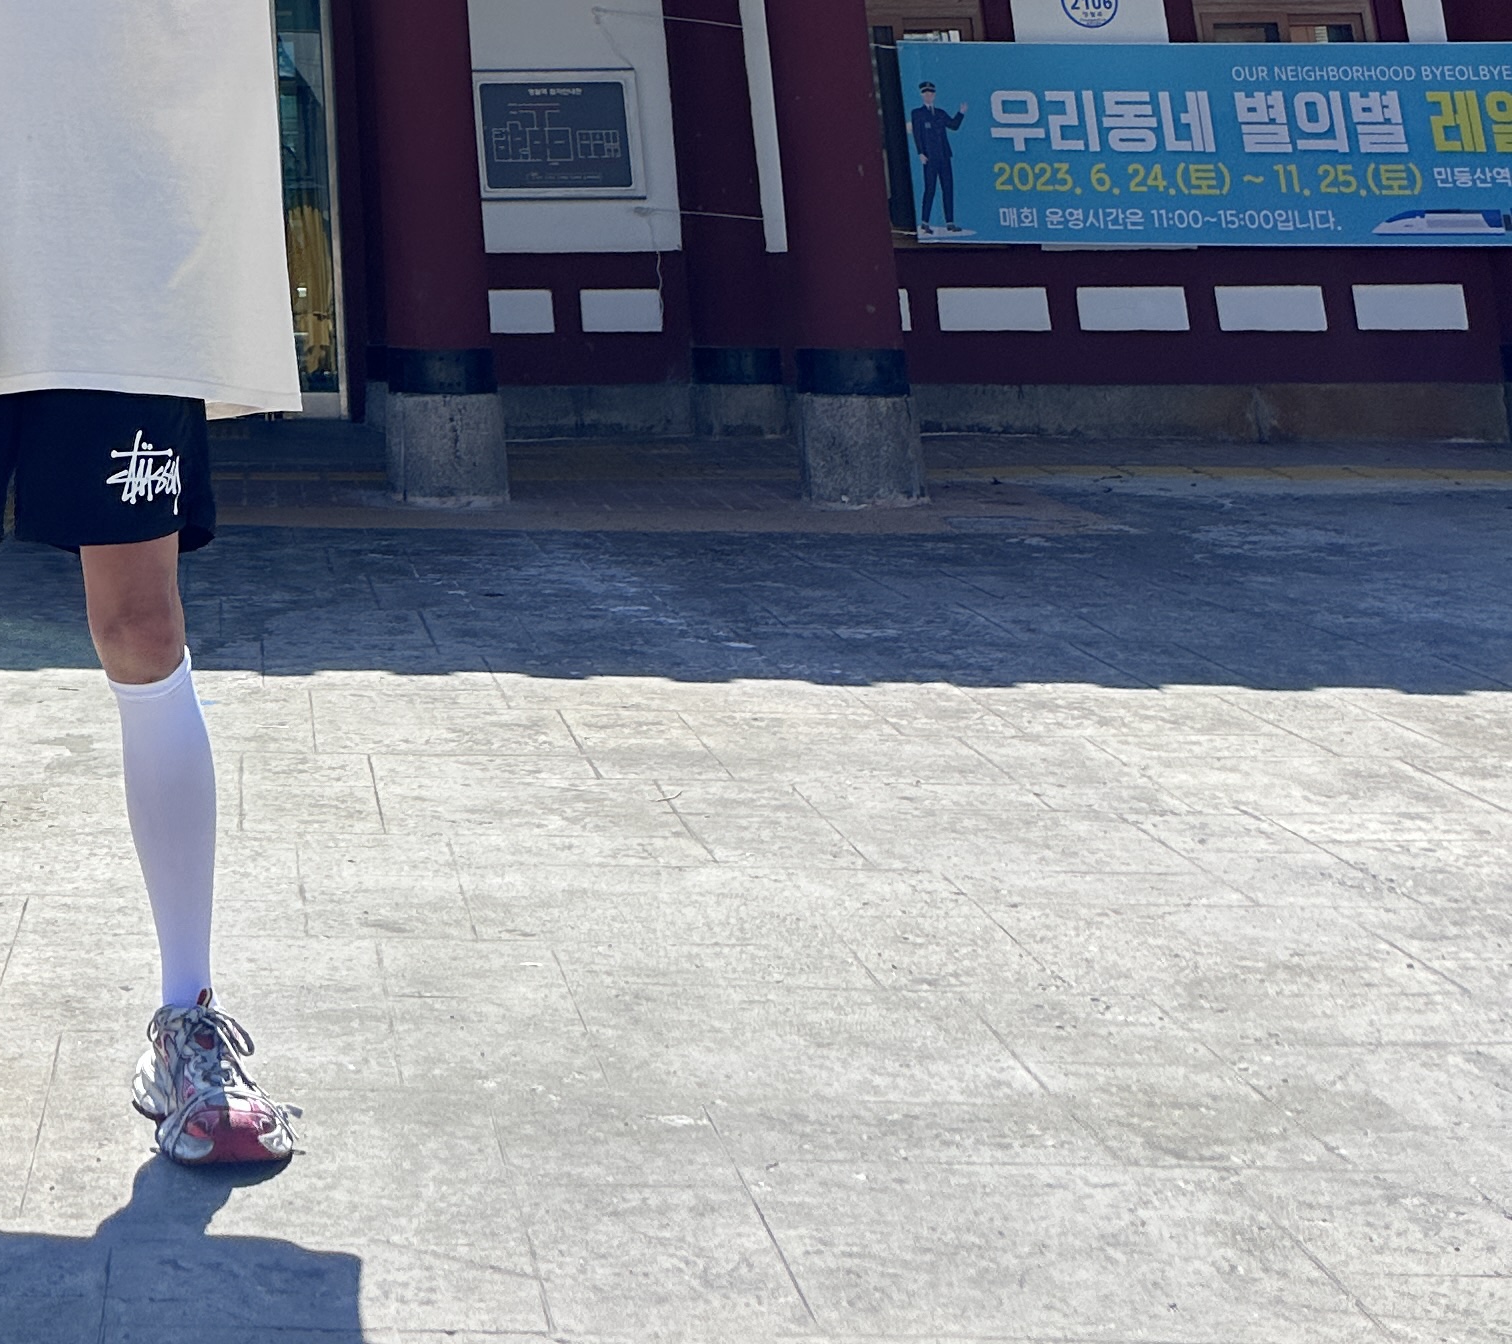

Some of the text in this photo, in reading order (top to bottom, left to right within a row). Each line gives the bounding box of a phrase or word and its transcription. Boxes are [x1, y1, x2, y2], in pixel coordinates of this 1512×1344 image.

[1231, 64, 1512, 81] OUR NEIGHBORHOOD BYEOLBYE
[990, 89, 1217, 153] 우리동네
[1233, 90, 1410, 153] 별의별
[993, 162, 1083, 196] 2023.
[1090, 162, 1121, 197] 6.
[1127, 161, 1231, 196] 24.(토)
[1273, 163, 1311, 197] 11.
[1317, 162, 1423, 197] 25.(토)
[1433, 167, 1512, 187] 민둥산역
[998, 207, 1342, 231] 매회 운영시간은 11:00~15:00입니다.
